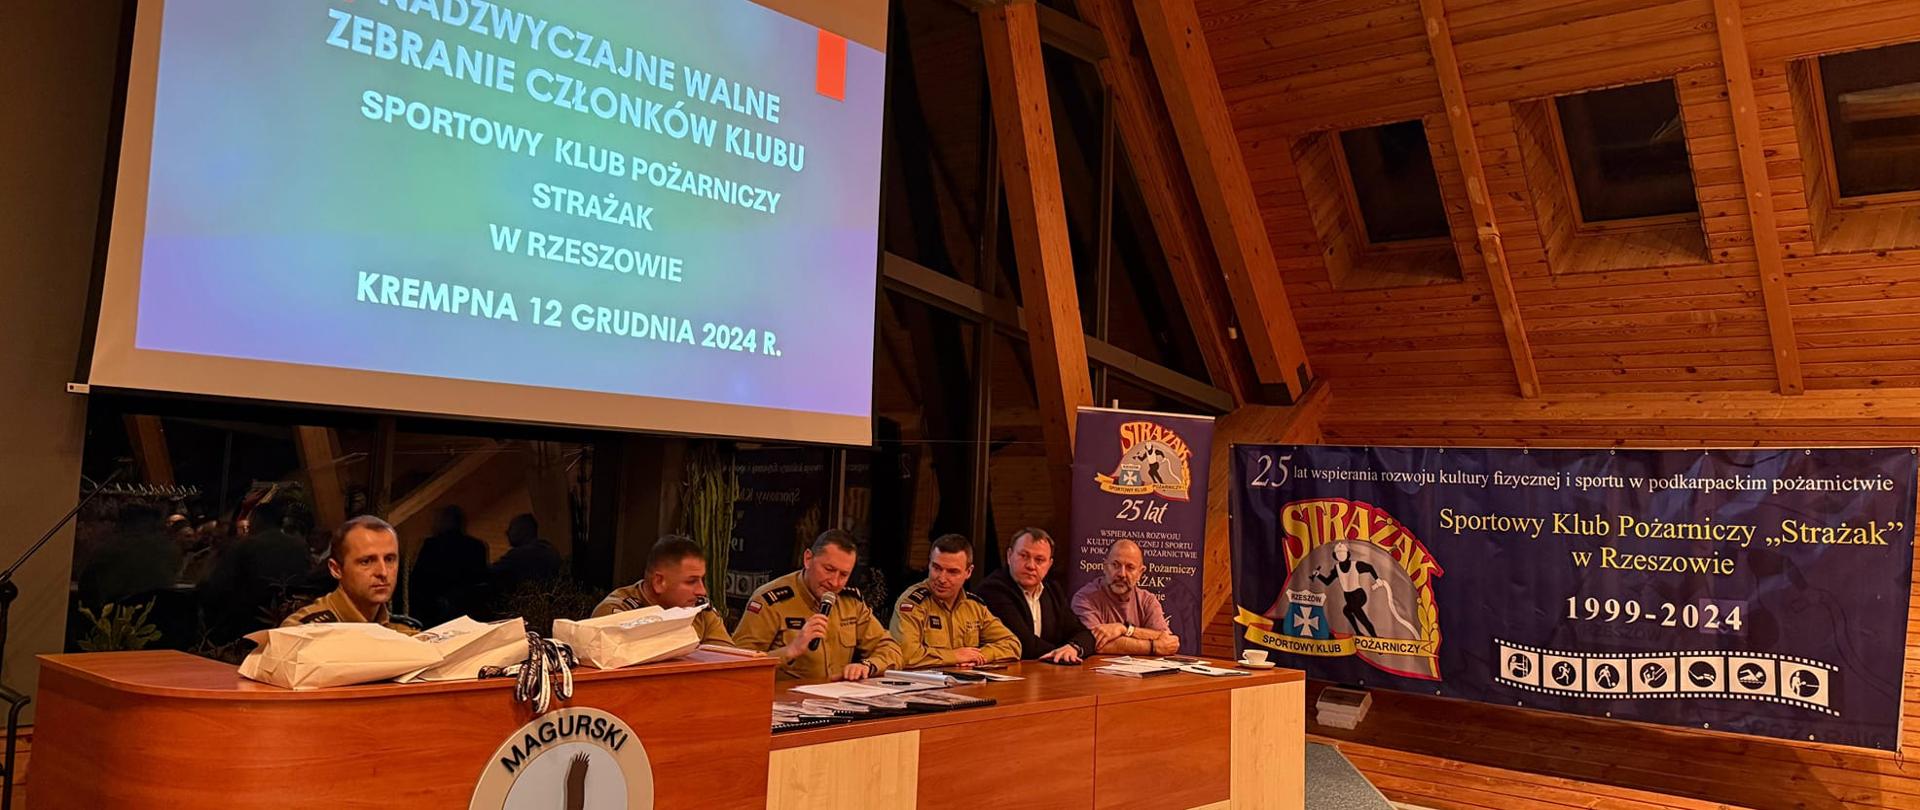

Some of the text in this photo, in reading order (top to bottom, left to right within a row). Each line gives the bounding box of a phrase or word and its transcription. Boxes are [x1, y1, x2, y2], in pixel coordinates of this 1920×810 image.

[326, 8, 805, 172] ZEBRANIE CZŁONKÓW KLUBU
[684, 66, 780, 124] WALNE
[361, 90, 781, 214] SPORTOWY KLUB POŻARNICZY
[532, 183, 653, 231] STRAŻAK
[489, 223, 683, 282] W RZESZOWIE
[356, 271, 782, 357] KREMPNA 12 GRUDNIA 2024 R.
[1120, 421, 1192, 461] STRAŻAK
[1251, 454, 1894, 494] 25 lat wspierania rozwoju kultury fizycznej i sportu w podkarpackim pożarnictwie
[1116, 499, 1169, 524] 25 lat
[1440, 508, 1545, 539] Sportowy
[1552, 512, 1610, 536] Klub
[1618, 515, 1757, 548] Pożarniczy
[1100, 529, 1181, 541] WSPIERANIA ROZWOJU
[1165, 541, 1193, 550] SPORTU
[1282, 501, 1438, 586] STRAŻAK
[1149, 562, 1197, 576] Pożarniczy
[1571, 547, 1735, 575] w Rzeszowie
[1291, 592, 1323, 603] RZESZÓW
[1567, 596, 1743, 631] 1999-2024
[1262, 634, 1342, 653] SPORTOWY KLUB
[1354, 637, 1421, 654] POŻARNICZY
[501, 714, 628, 773] MAGURSKI
